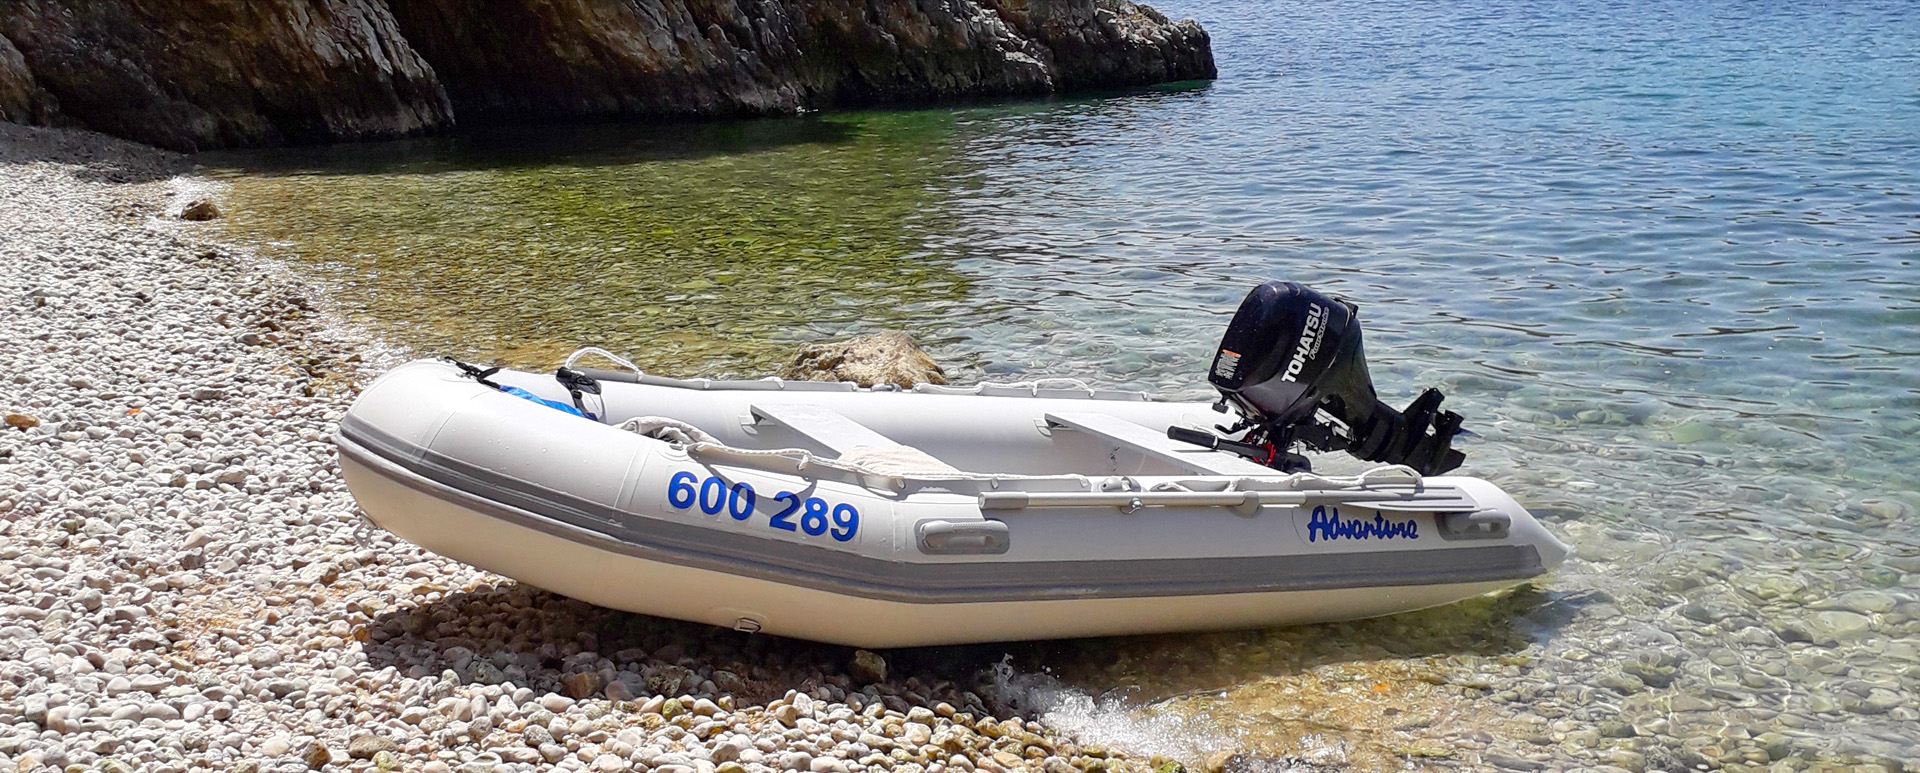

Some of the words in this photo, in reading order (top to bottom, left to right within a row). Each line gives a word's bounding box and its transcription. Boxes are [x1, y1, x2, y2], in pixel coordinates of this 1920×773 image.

[1281, 302, 1322, 383] TOHATSU
[668, 471, 756, 522] 600
[769, 491, 859, 542] 289
[1307, 505, 1419, 543] Adventure
